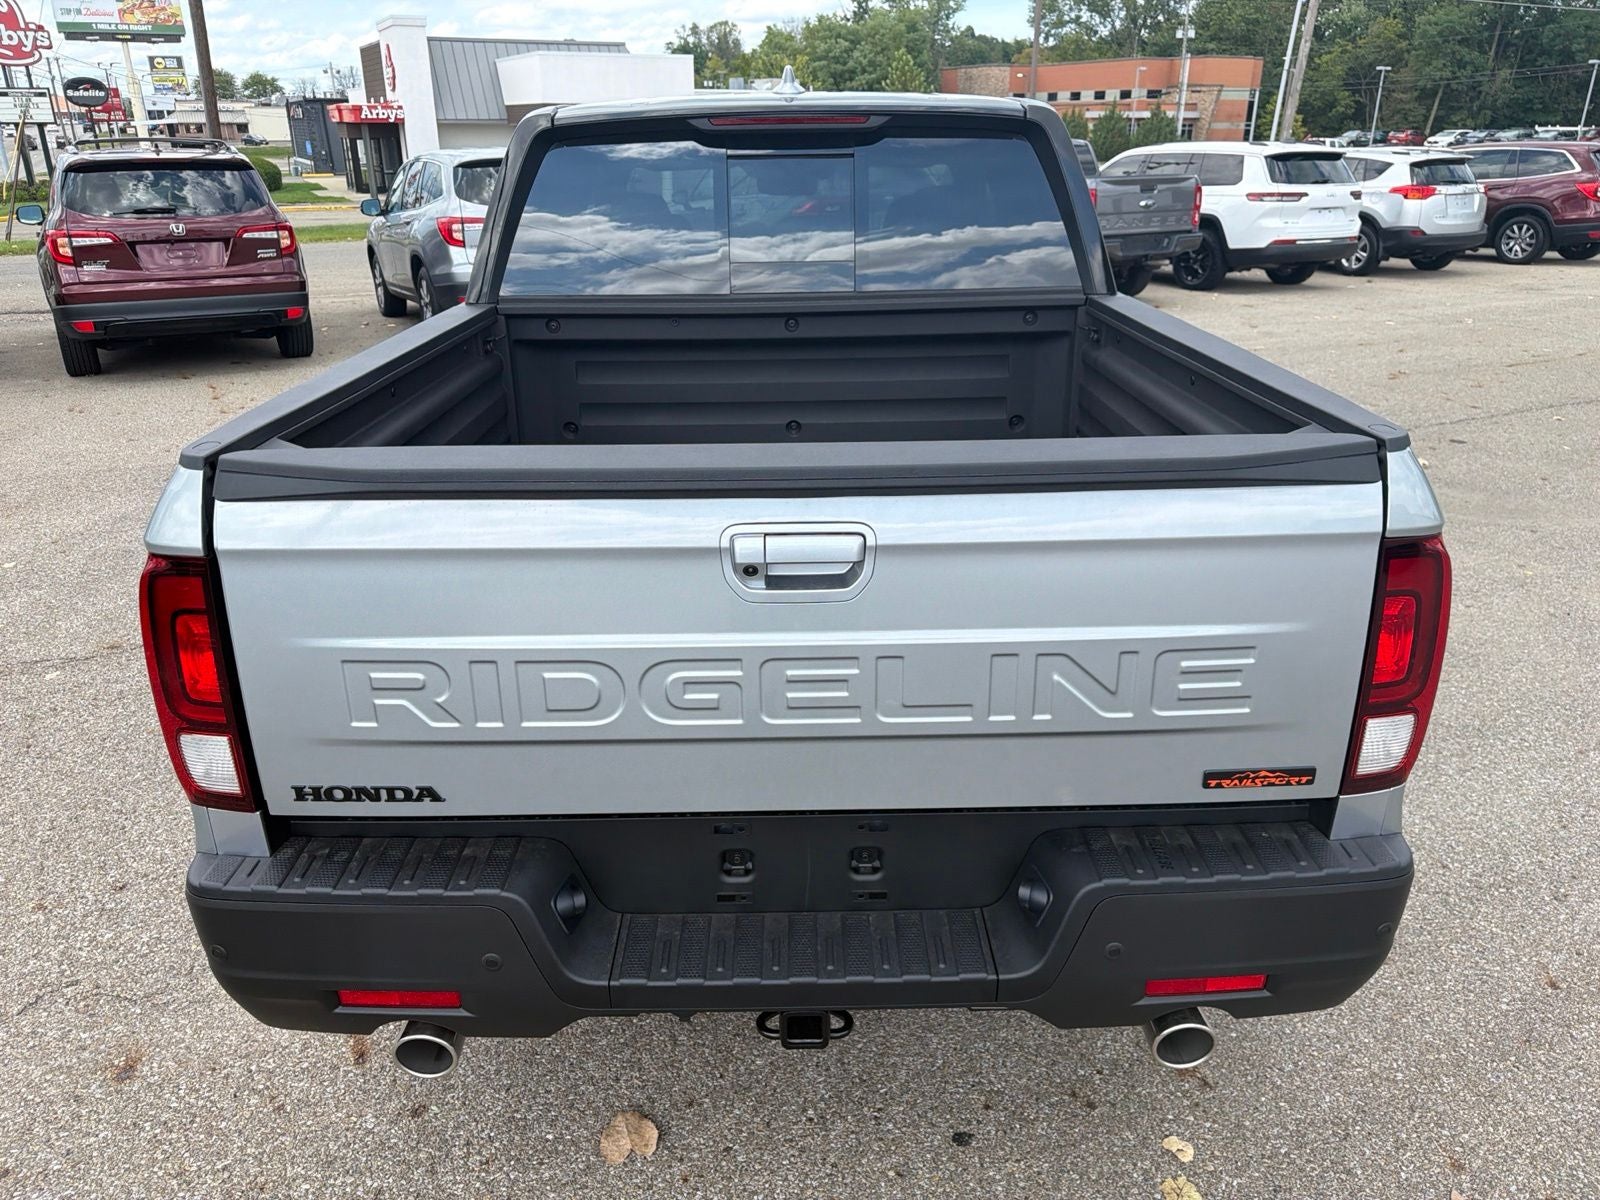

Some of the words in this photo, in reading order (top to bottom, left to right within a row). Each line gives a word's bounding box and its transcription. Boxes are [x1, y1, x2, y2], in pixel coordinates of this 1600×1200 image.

[66, 89, 106, 97] Safelite
[360, 104, 405, 122] Arby's
[340, 646, 1257, 728] RIDGELINE
[1206, 775, 1313, 788] TRAILSPORT
[291, 785, 446, 802] HONDA
